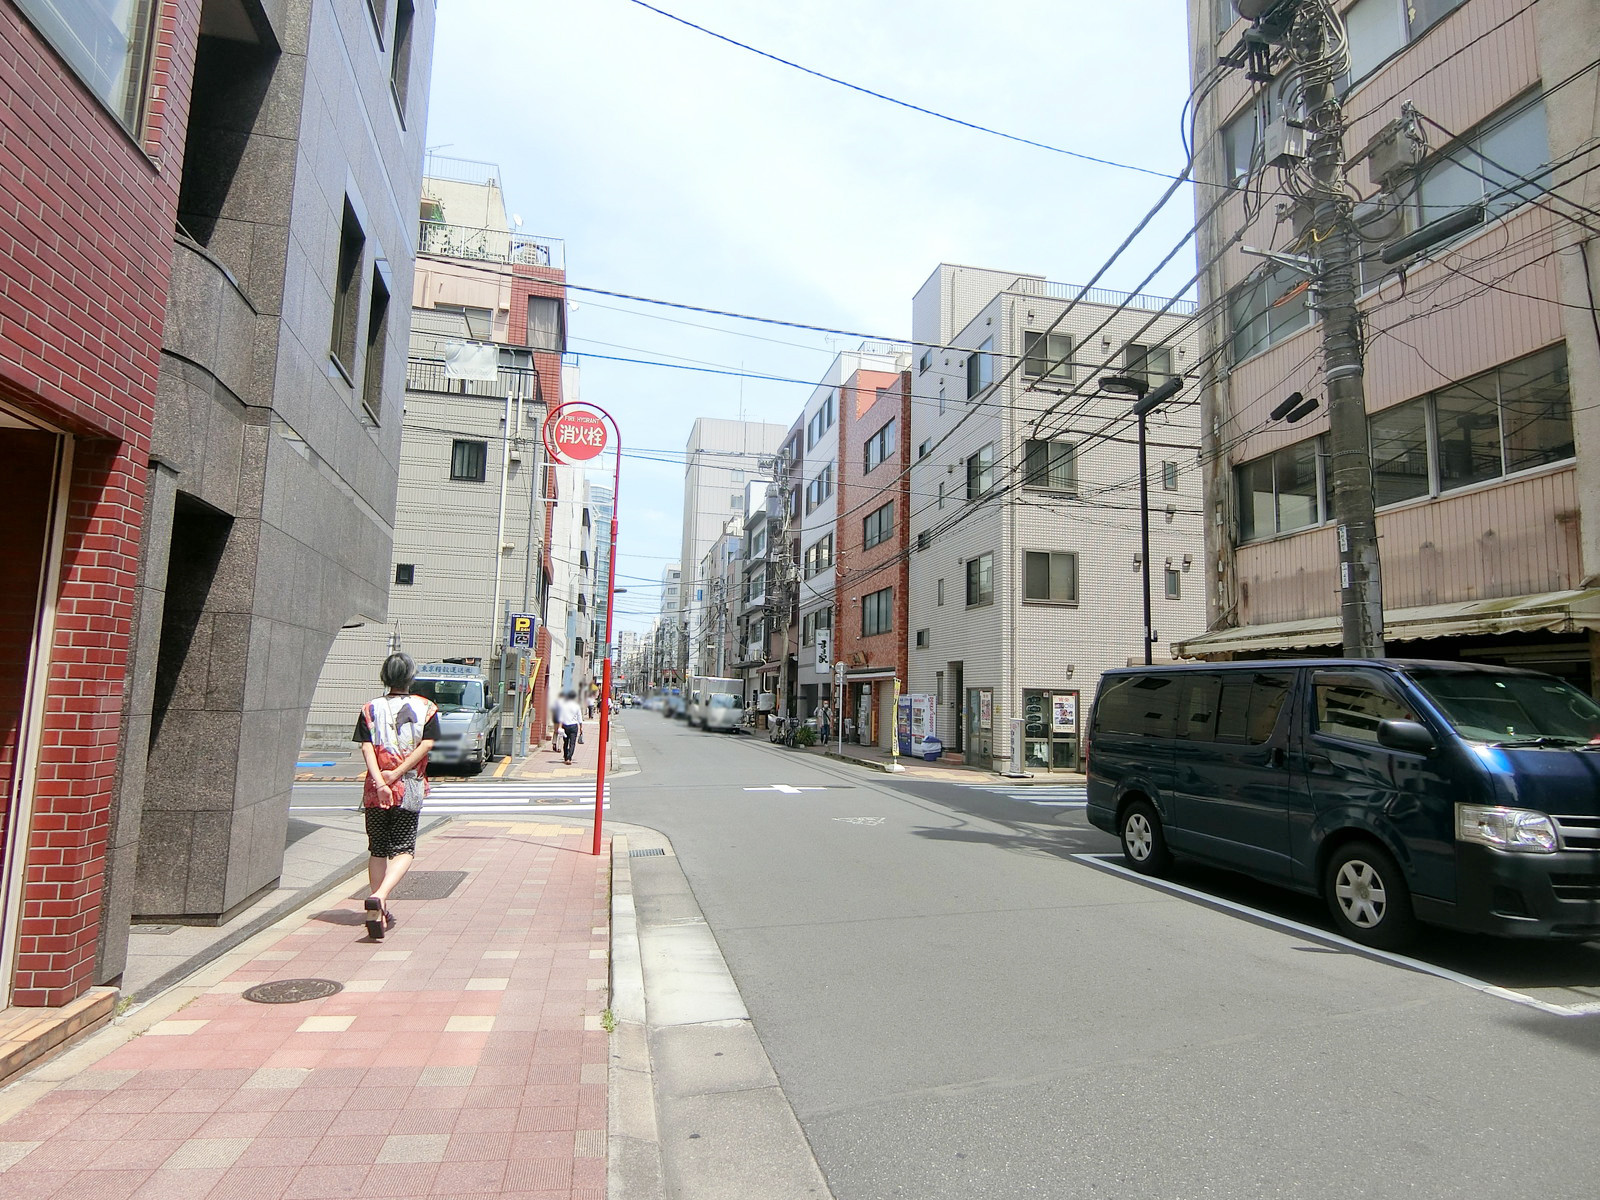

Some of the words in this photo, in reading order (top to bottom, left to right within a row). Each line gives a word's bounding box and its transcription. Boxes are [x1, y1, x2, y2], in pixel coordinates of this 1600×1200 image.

[576, 416, 599, 424] HYDRANT
[560, 424, 604, 447] 消火栓
[515, 618, 530, 632] P
